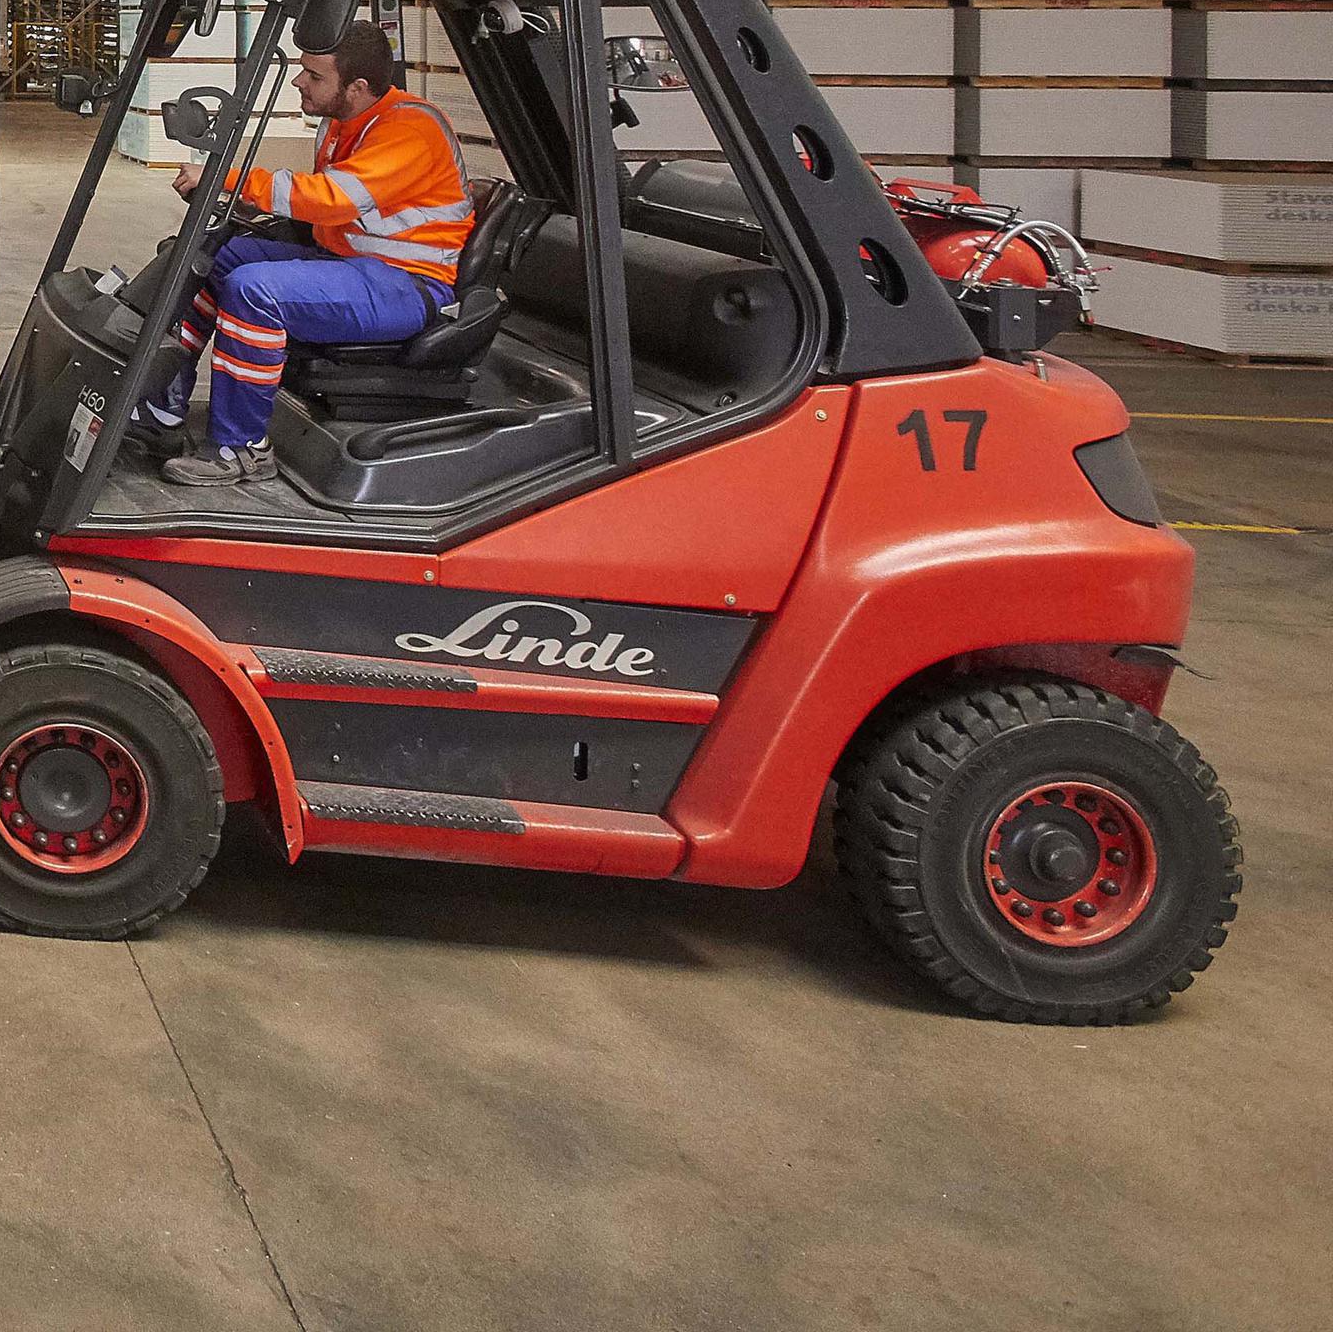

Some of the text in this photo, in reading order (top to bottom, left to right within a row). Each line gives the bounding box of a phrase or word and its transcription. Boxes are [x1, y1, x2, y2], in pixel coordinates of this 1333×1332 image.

[77, 384, 106, 413] H60
[896, 408, 989, 472] 17
[394, 600, 655, 678] Linde
